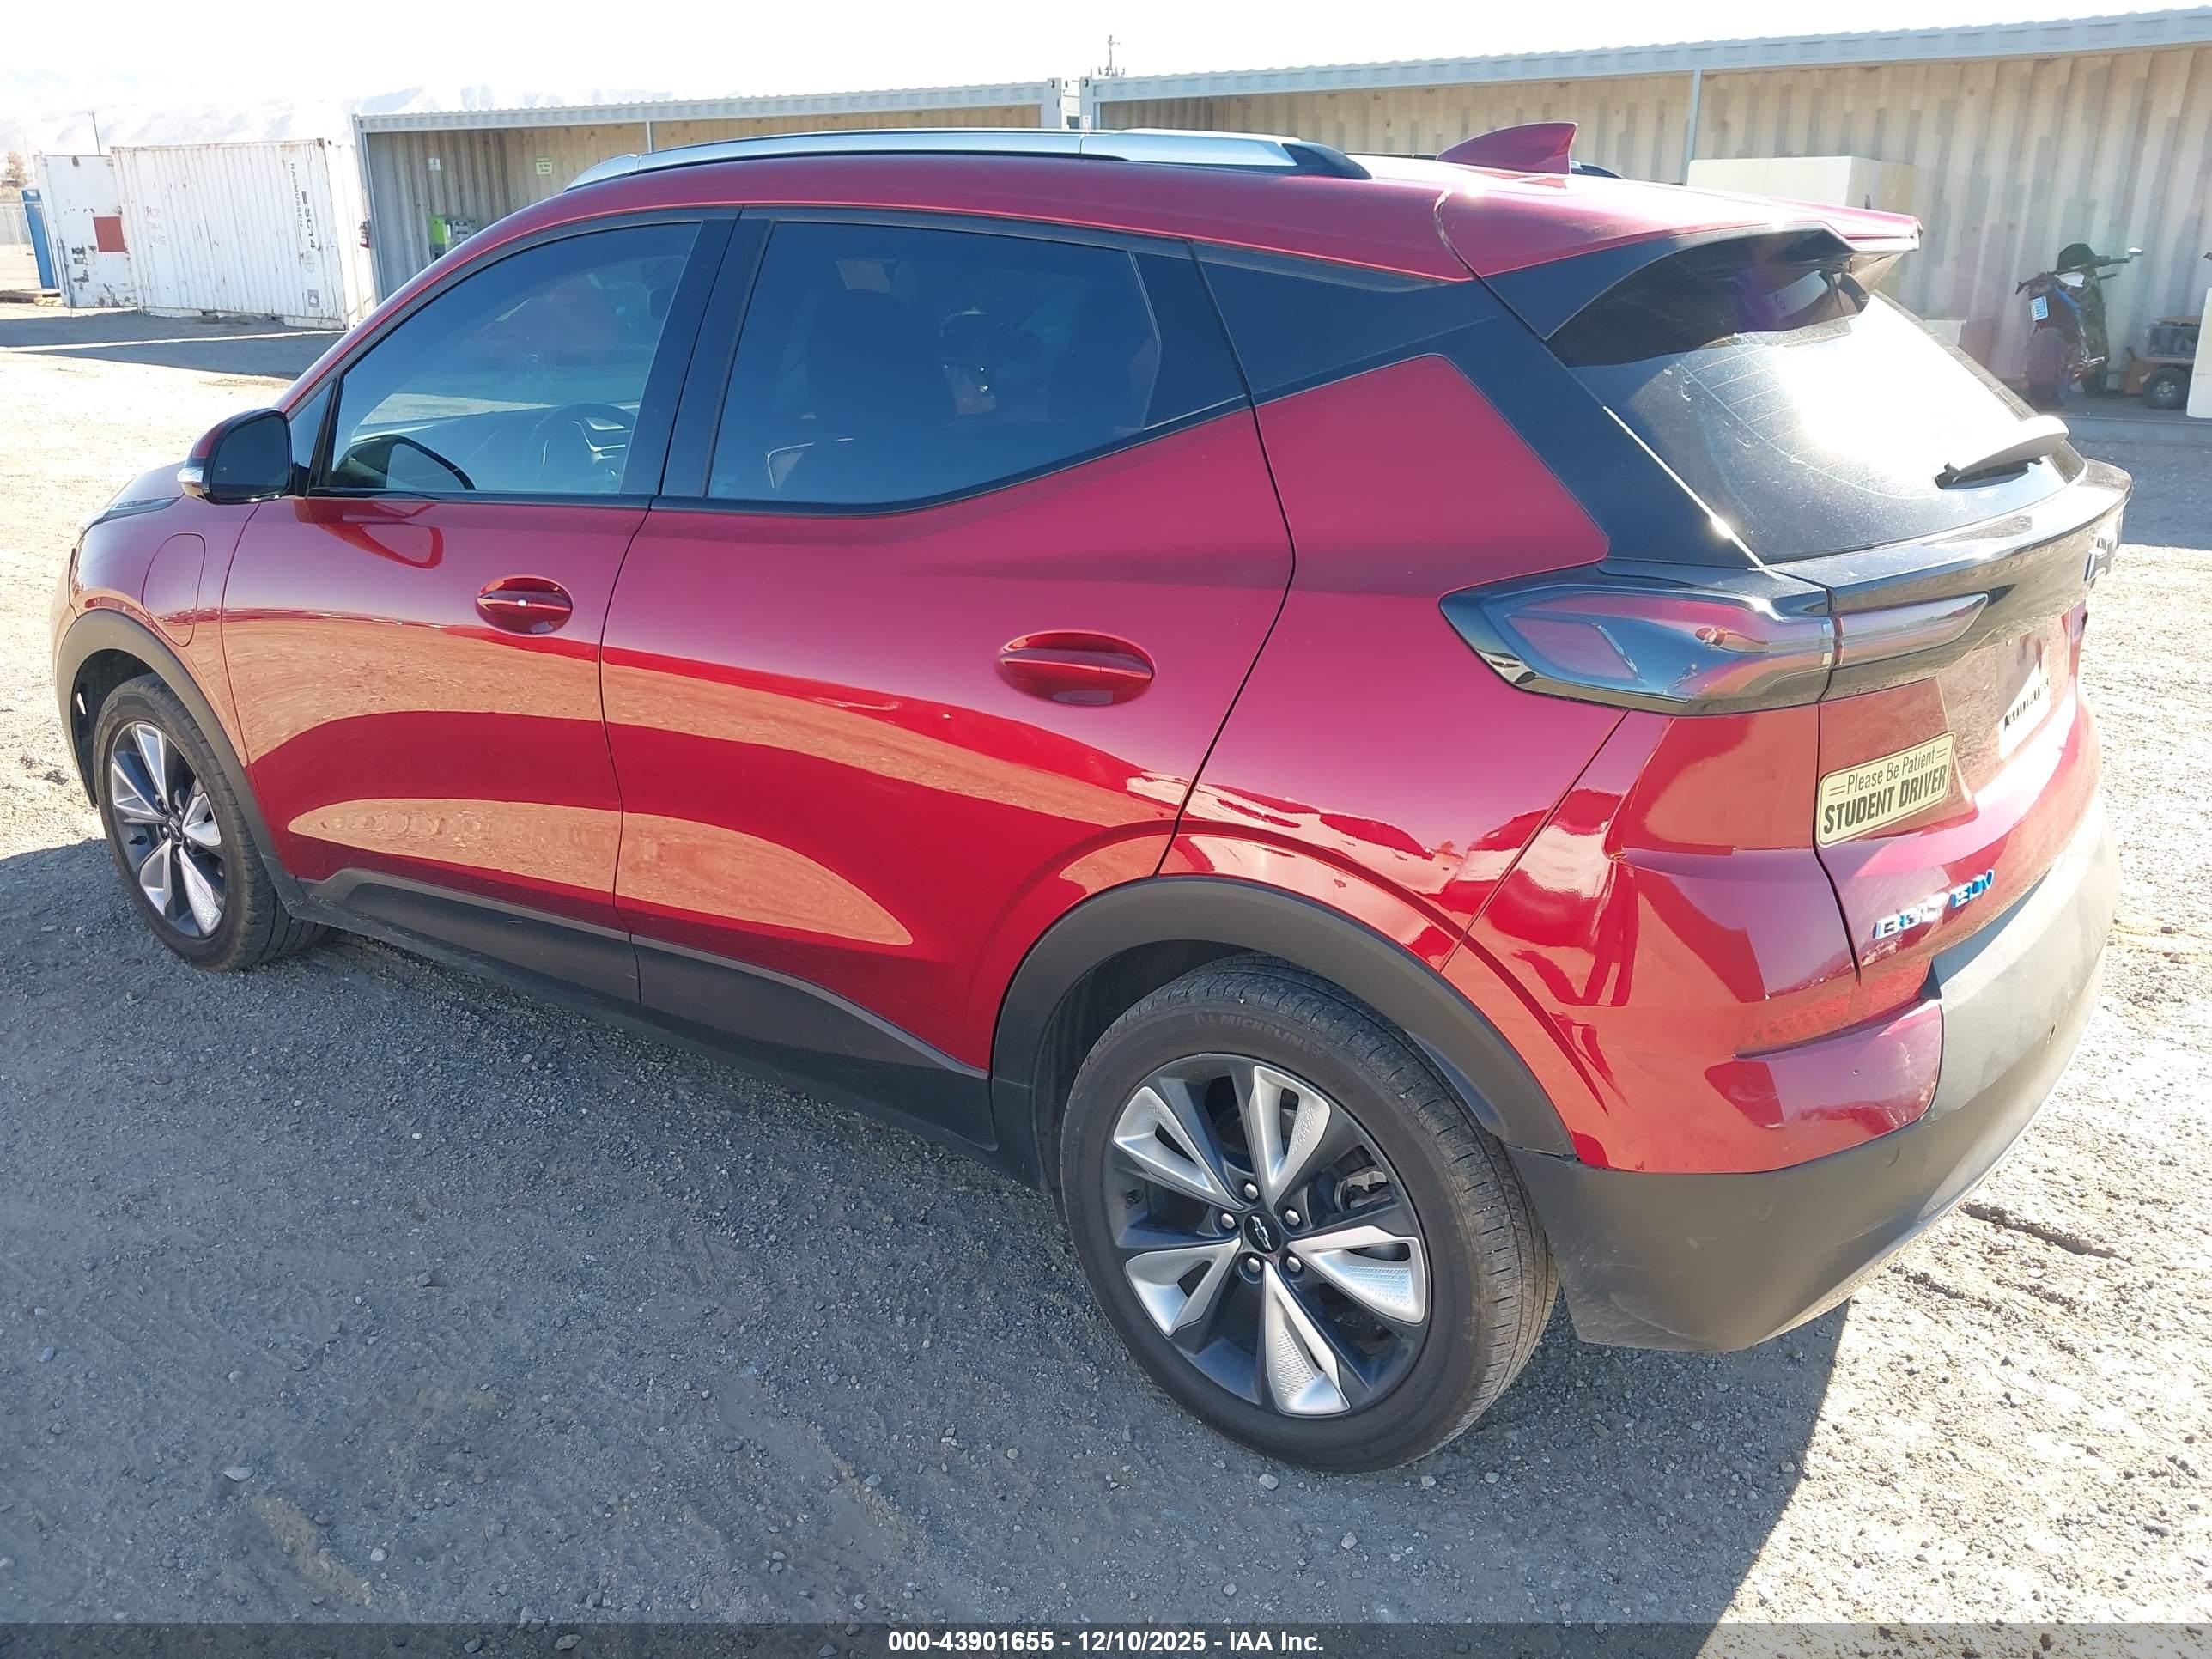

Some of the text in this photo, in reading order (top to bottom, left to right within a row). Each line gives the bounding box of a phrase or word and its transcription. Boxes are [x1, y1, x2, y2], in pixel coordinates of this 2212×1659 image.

[290, 163, 303, 227] RASMUSSEN
[1847, 746, 1936, 795] Please Be Patient
[1823, 764, 1948, 835] STUDENT DRIVER
[1219, 1014, 1306, 1048] MICHELIN
